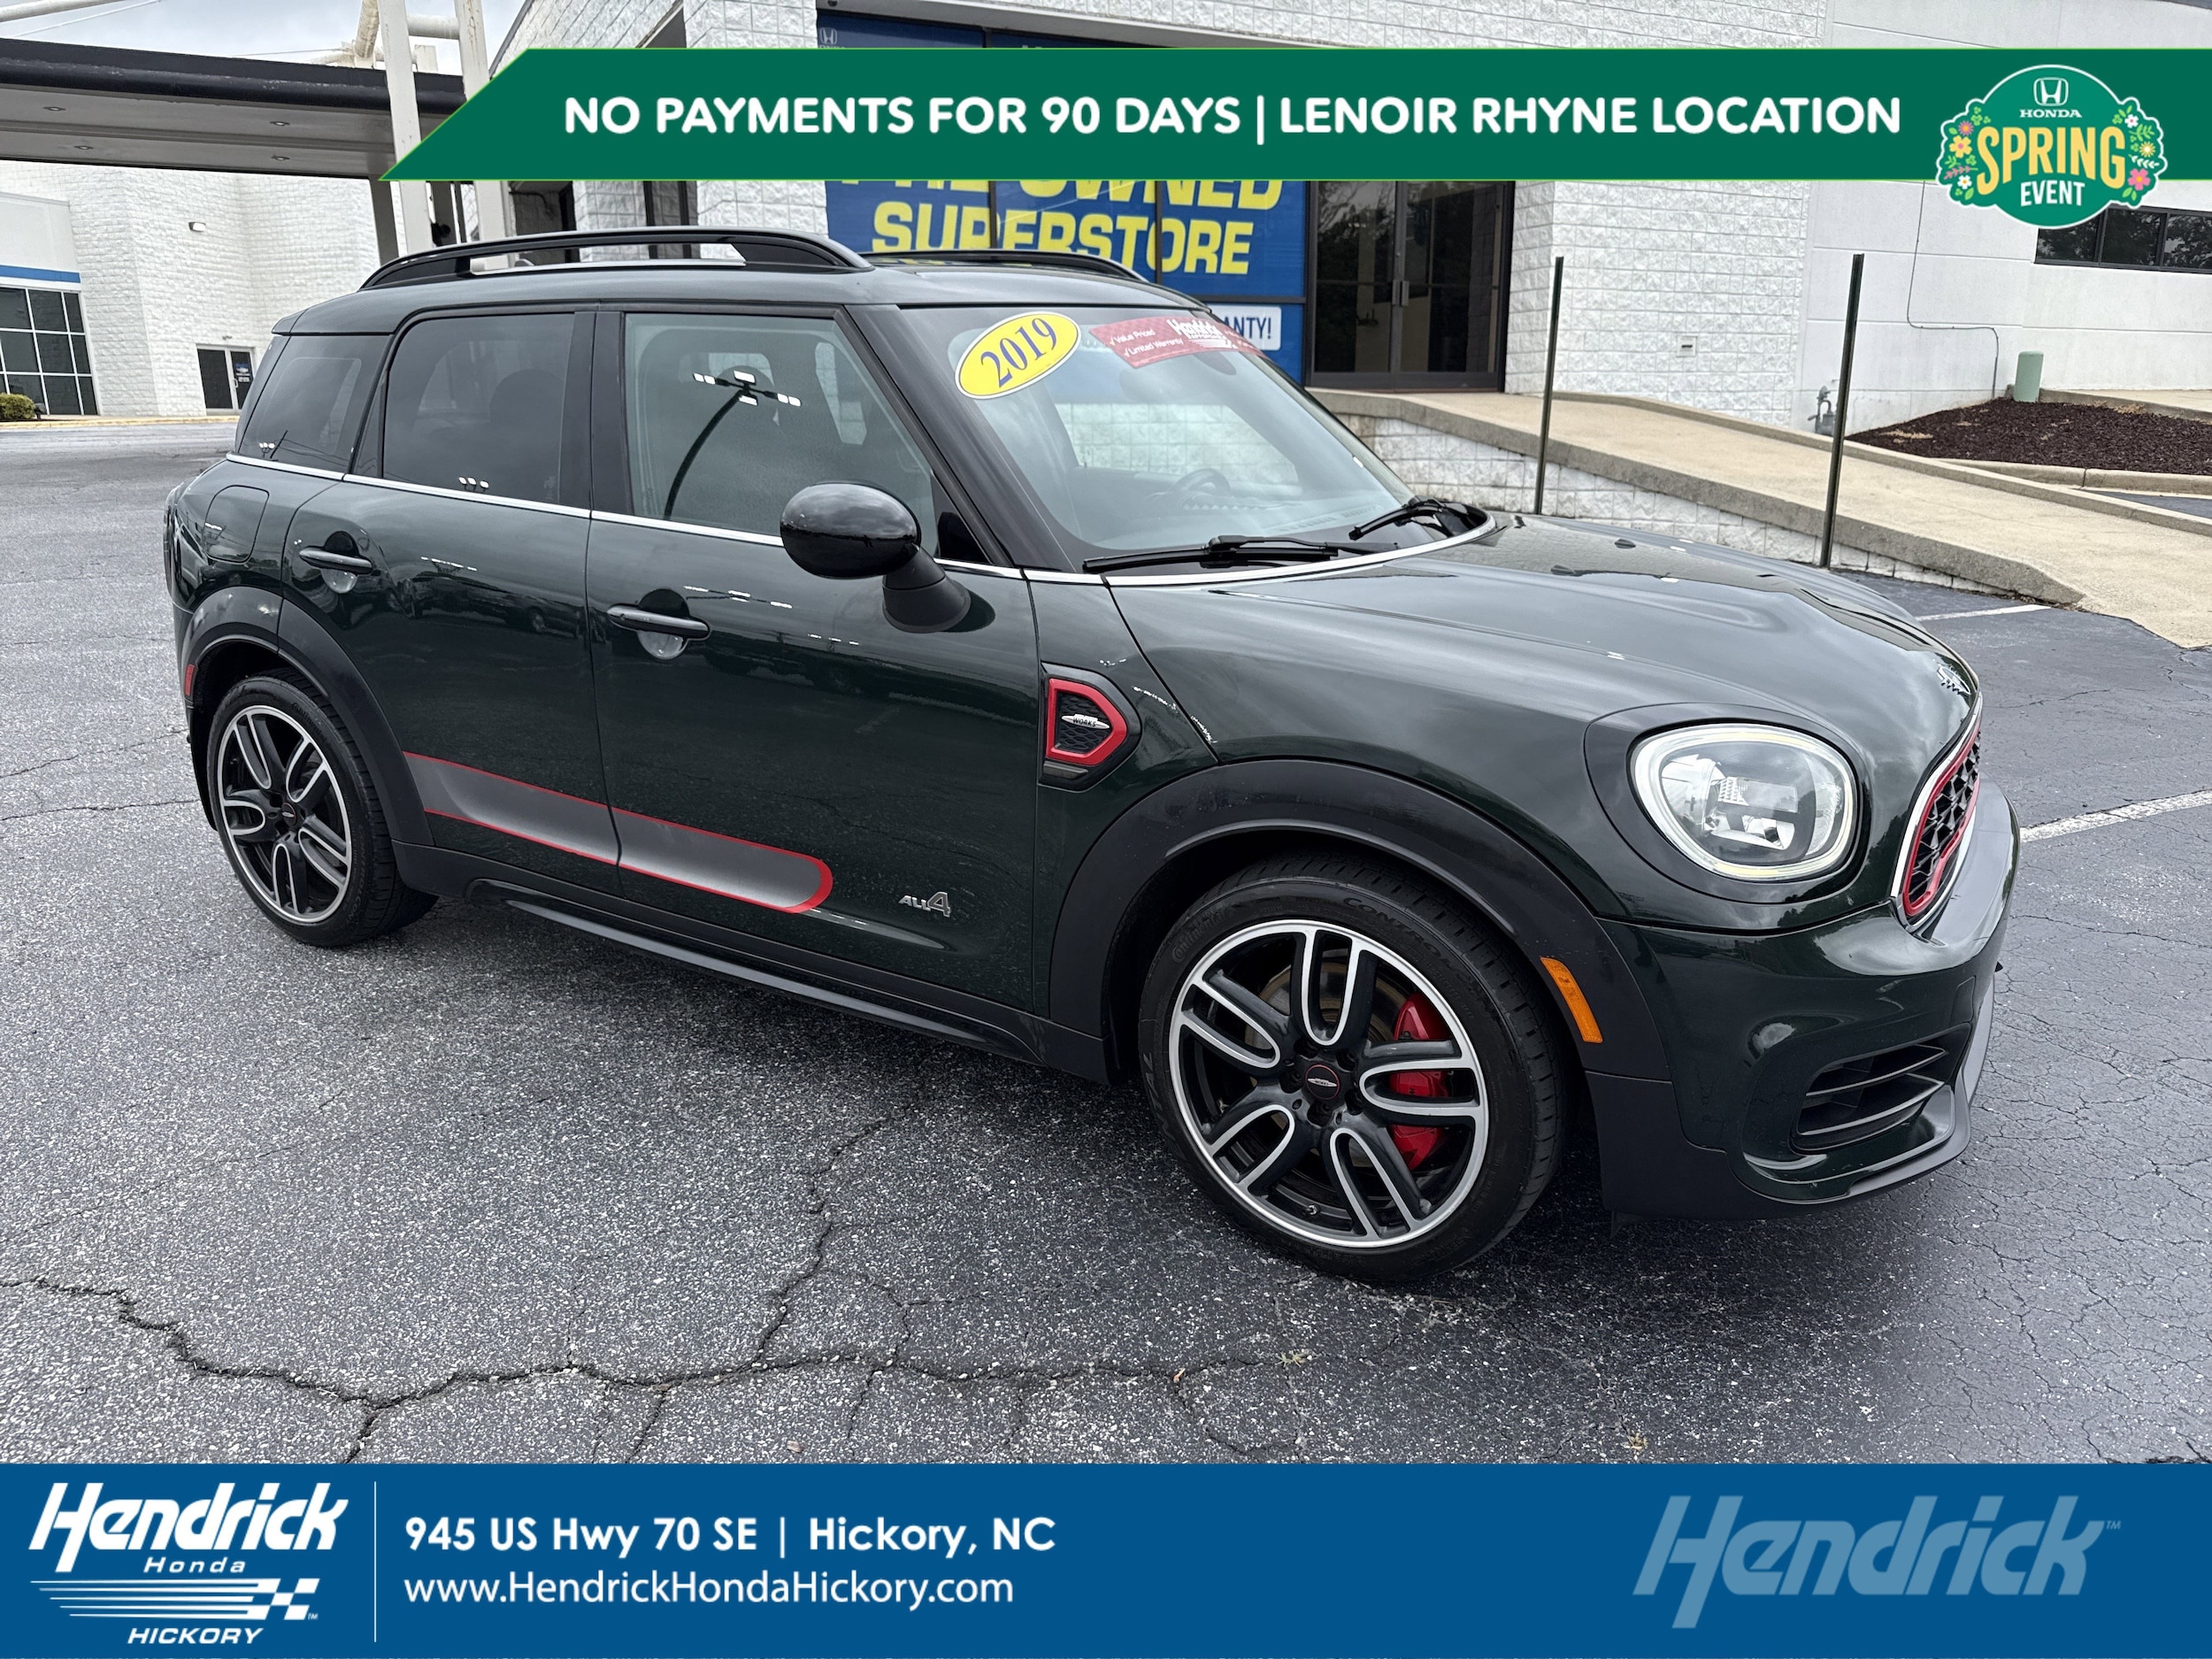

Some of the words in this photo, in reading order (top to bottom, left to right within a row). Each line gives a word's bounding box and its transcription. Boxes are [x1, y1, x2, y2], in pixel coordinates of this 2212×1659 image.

[871, 202, 1255, 275] SUPERSTORE
[979, 317, 1057, 388] 2019
[1072, 716, 1097, 728] WORKS
[898, 891, 951, 918] ALL4
